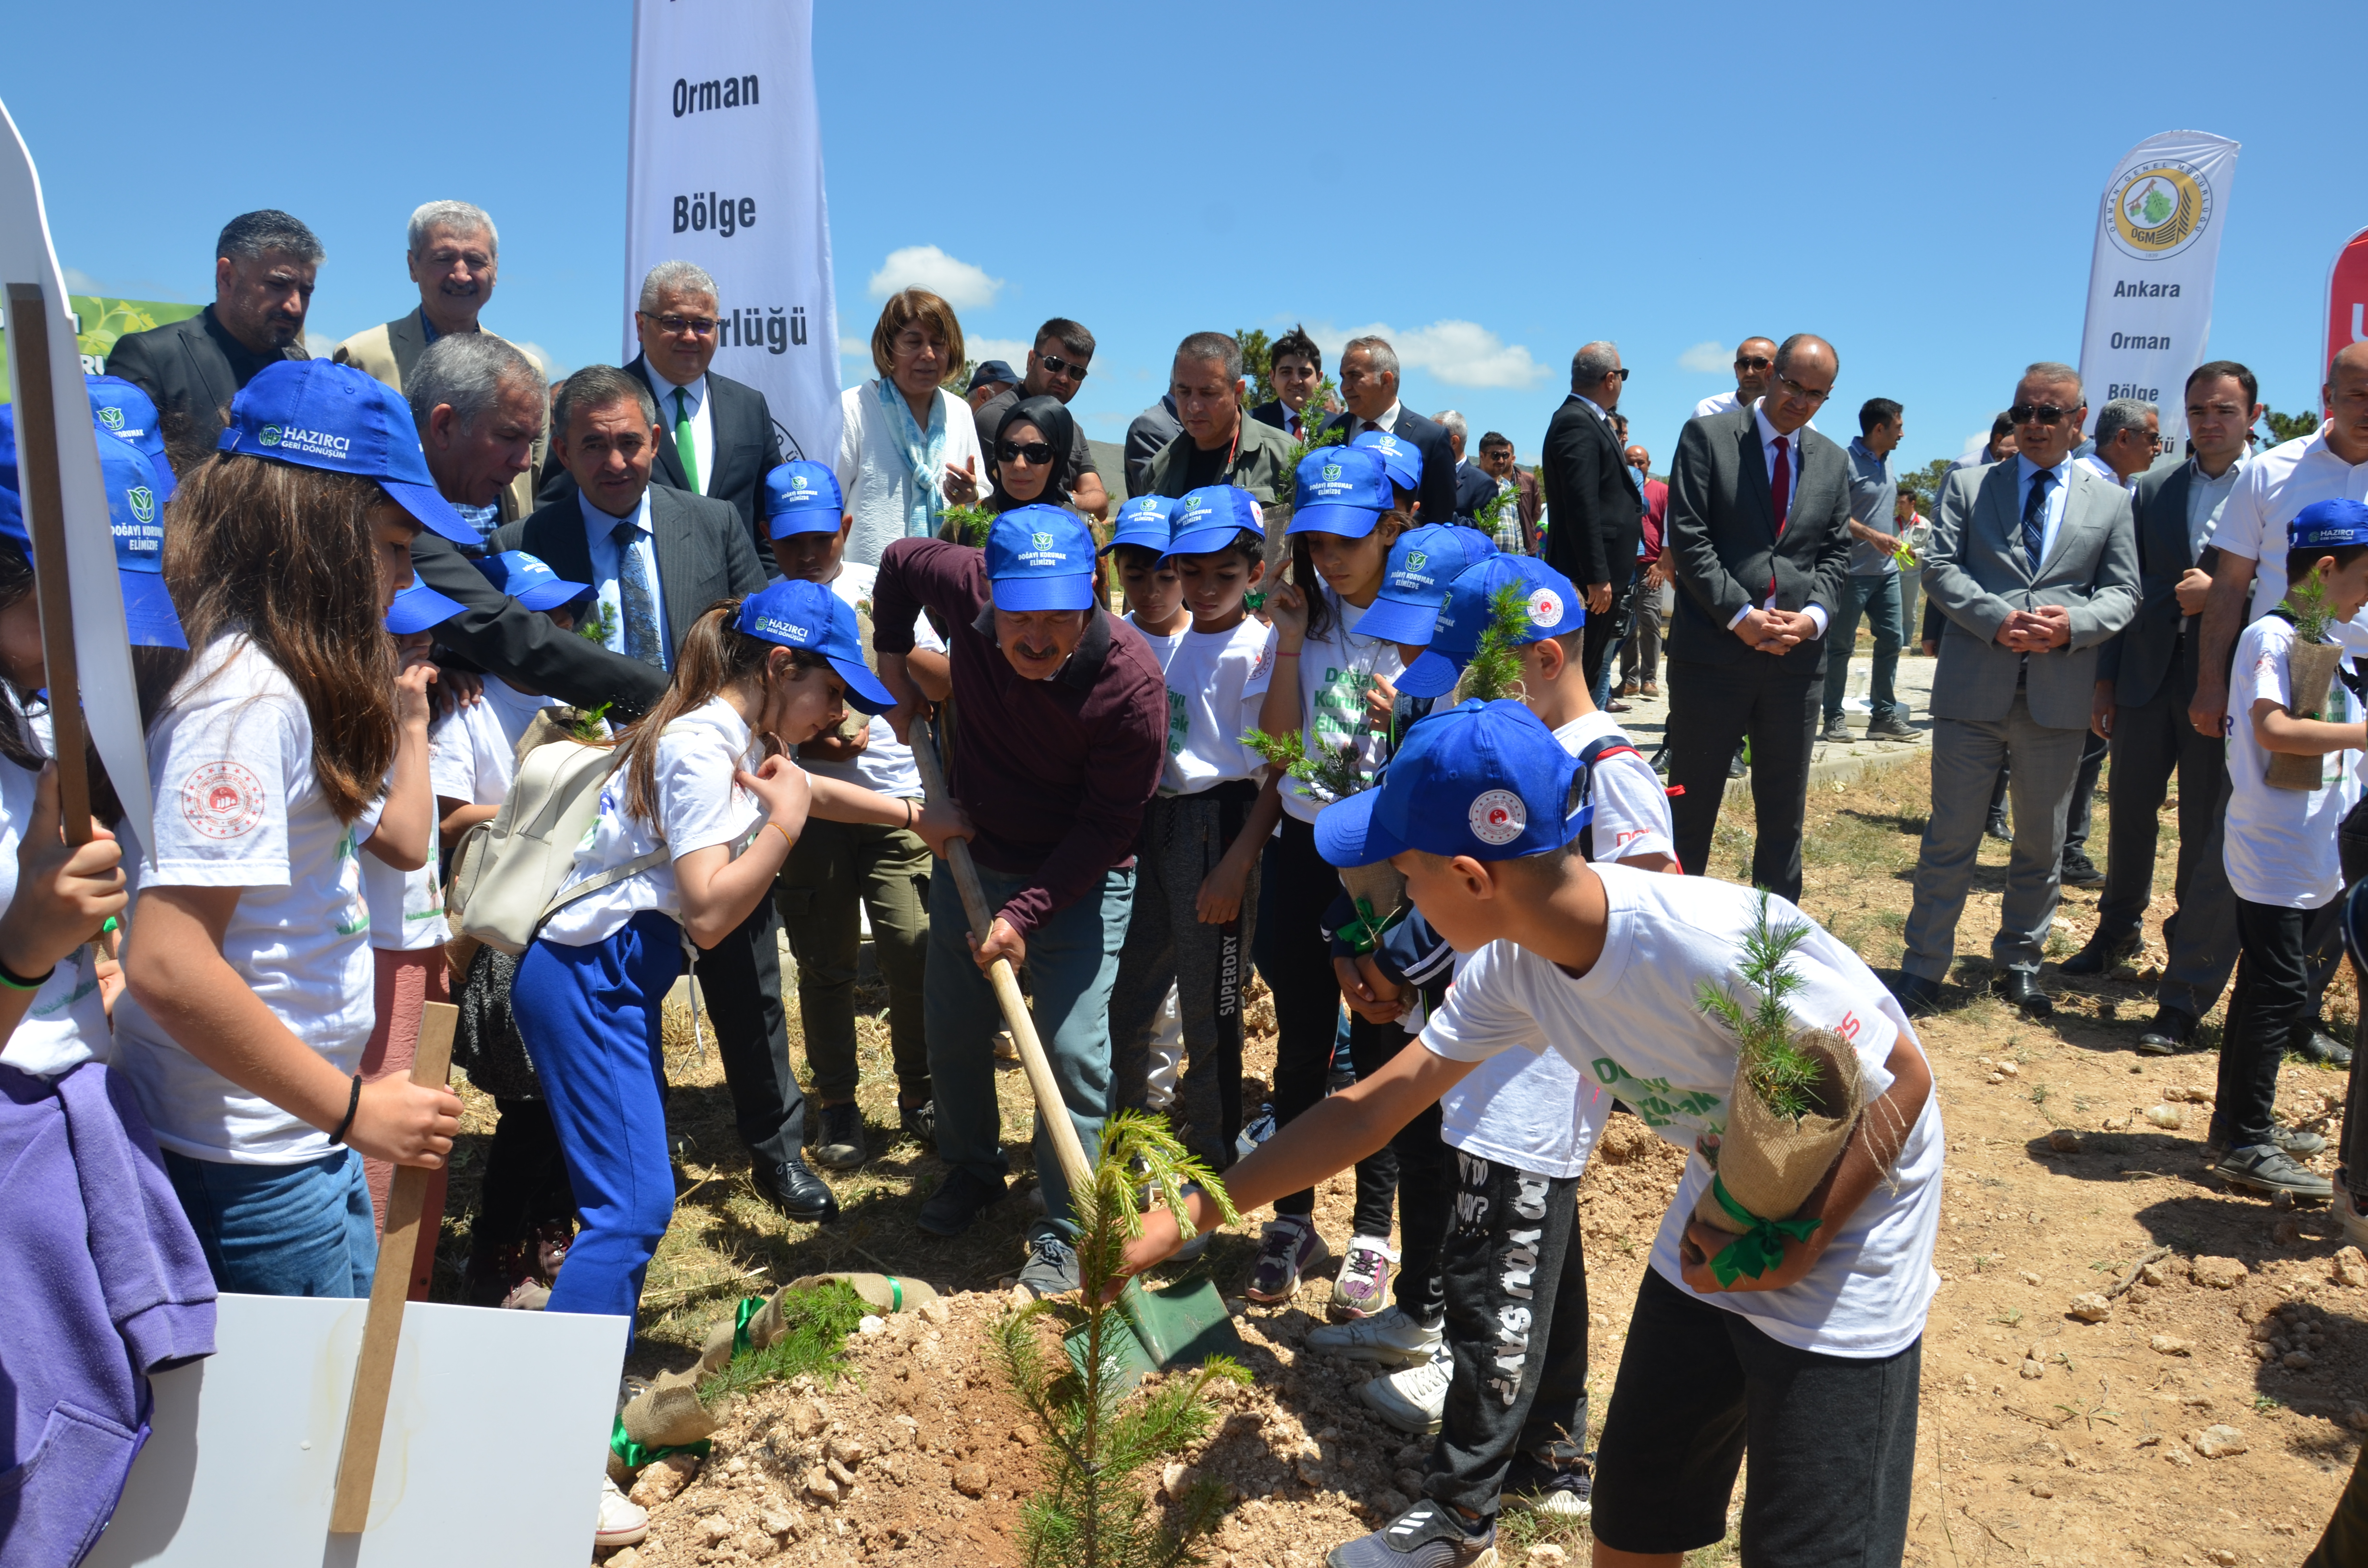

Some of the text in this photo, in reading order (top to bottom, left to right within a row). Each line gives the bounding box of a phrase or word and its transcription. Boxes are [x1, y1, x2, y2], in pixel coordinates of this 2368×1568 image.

[673, 74, 759, 118] Orman
[2107, 189, 2120, 233] ORMAN
[2124, 162, 2167, 182] GENEL
[673, 191, 756, 238] Bölge
[2131, 228, 2156, 245] OGM
[2113, 280, 2181, 298] Ankara
[720, 306, 807, 355] rlüğü
[2110, 331, 2171, 350] Orman
[2108, 384, 2159, 402] Bölge
[284, 427, 350, 451] HAZIRCI
[282, 441, 346, 459] GERİ DÖNÜŞÜM
[1309, 482, 1326, 490] DOĞAYI
[1183, 515, 1202, 526] ELİMİZDE
[1189, 508, 1212, 516] KORUMAK
[129, 537, 158, 551] ELİMİZDE
[1018, 551, 1066, 561] DOĞAYI KORUMAK
[1030, 558, 1056, 566] ELİMİZDE
[1395, 578, 1419, 590] ELİMİZDE
[1406, 572, 1435, 585] KORUMAK
[769, 618, 809, 637] HAZIRCI
[778, 630, 805, 643] DÖNÜŞÜM
[1167, 685, 1186, 709] ayı
[1220, 936, 1237, 1016] SUPERDRY
[1500, 1229, 1542, 1300] YOU
[1487, 1305, 1532, 1406] SAY?
